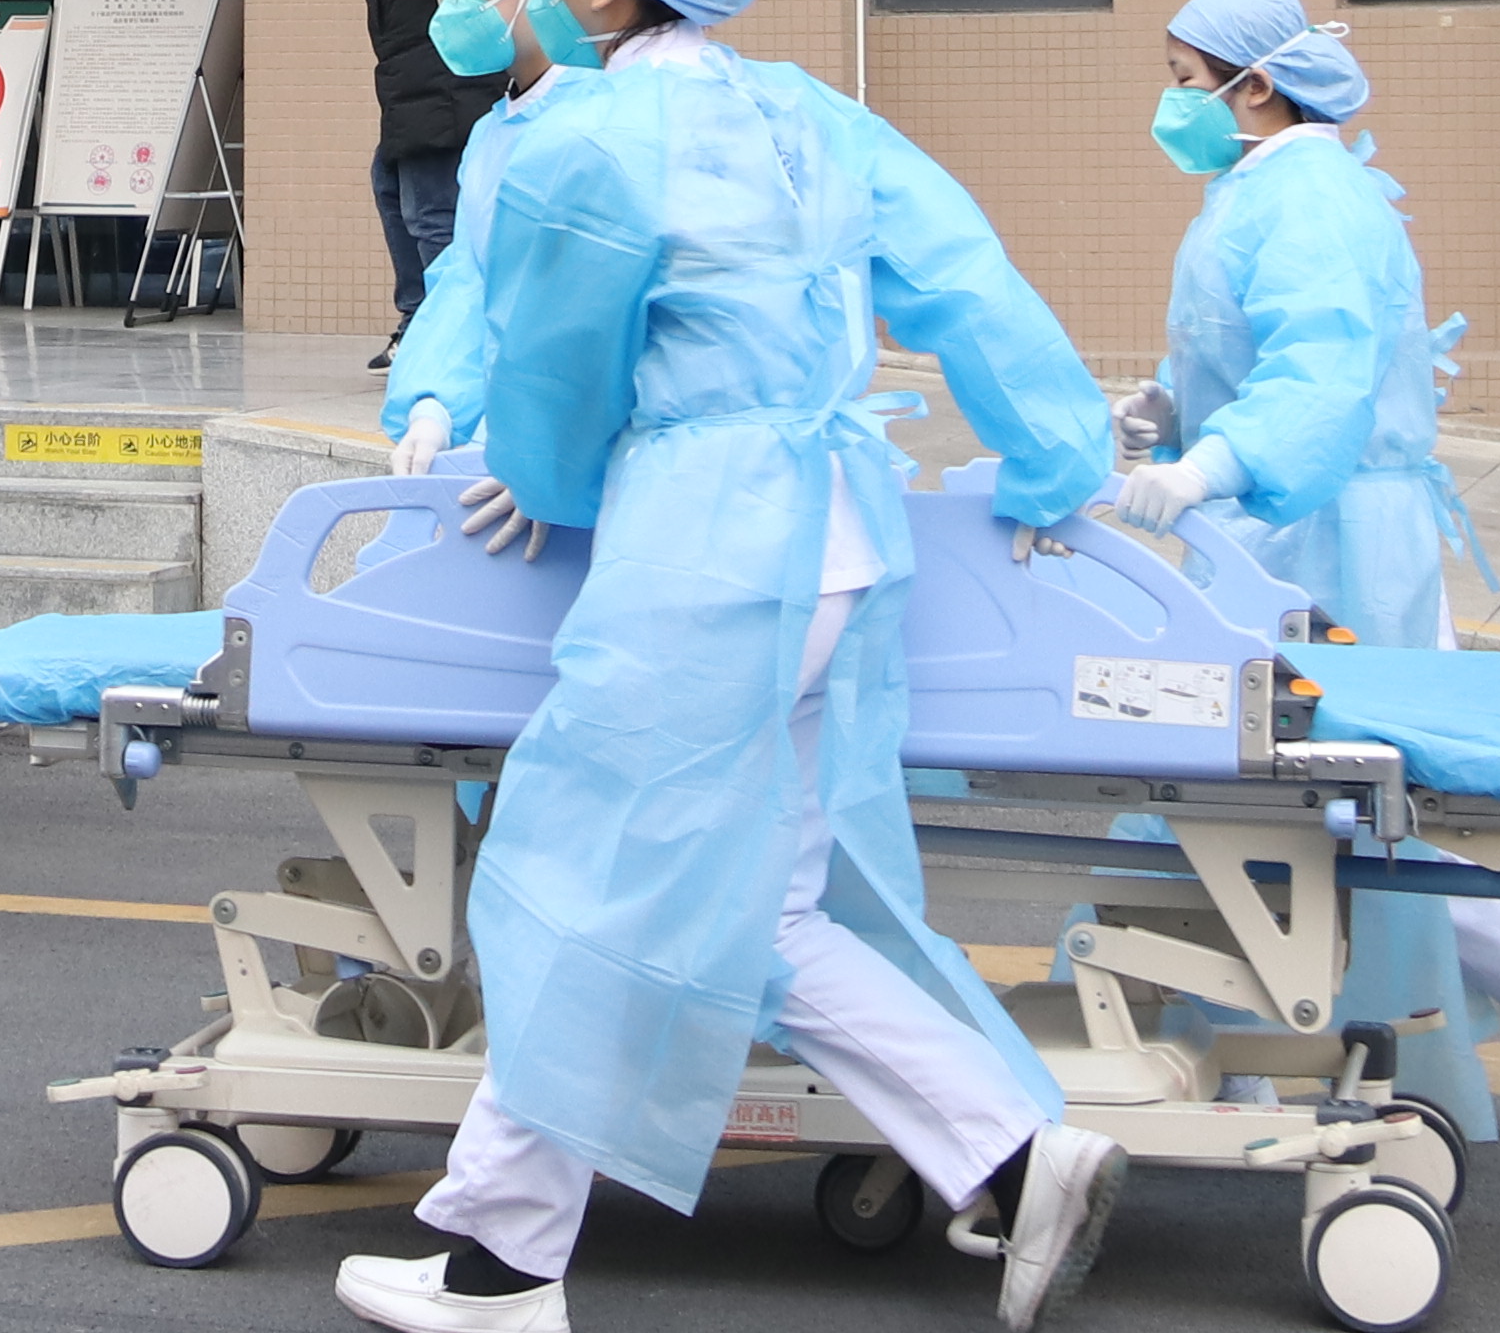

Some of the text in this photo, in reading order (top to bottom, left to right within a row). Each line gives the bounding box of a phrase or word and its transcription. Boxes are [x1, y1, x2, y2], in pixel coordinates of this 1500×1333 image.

[44, 431, 101, 447] 小心台阶
[145, 434, 202, 450] 小心地滑
